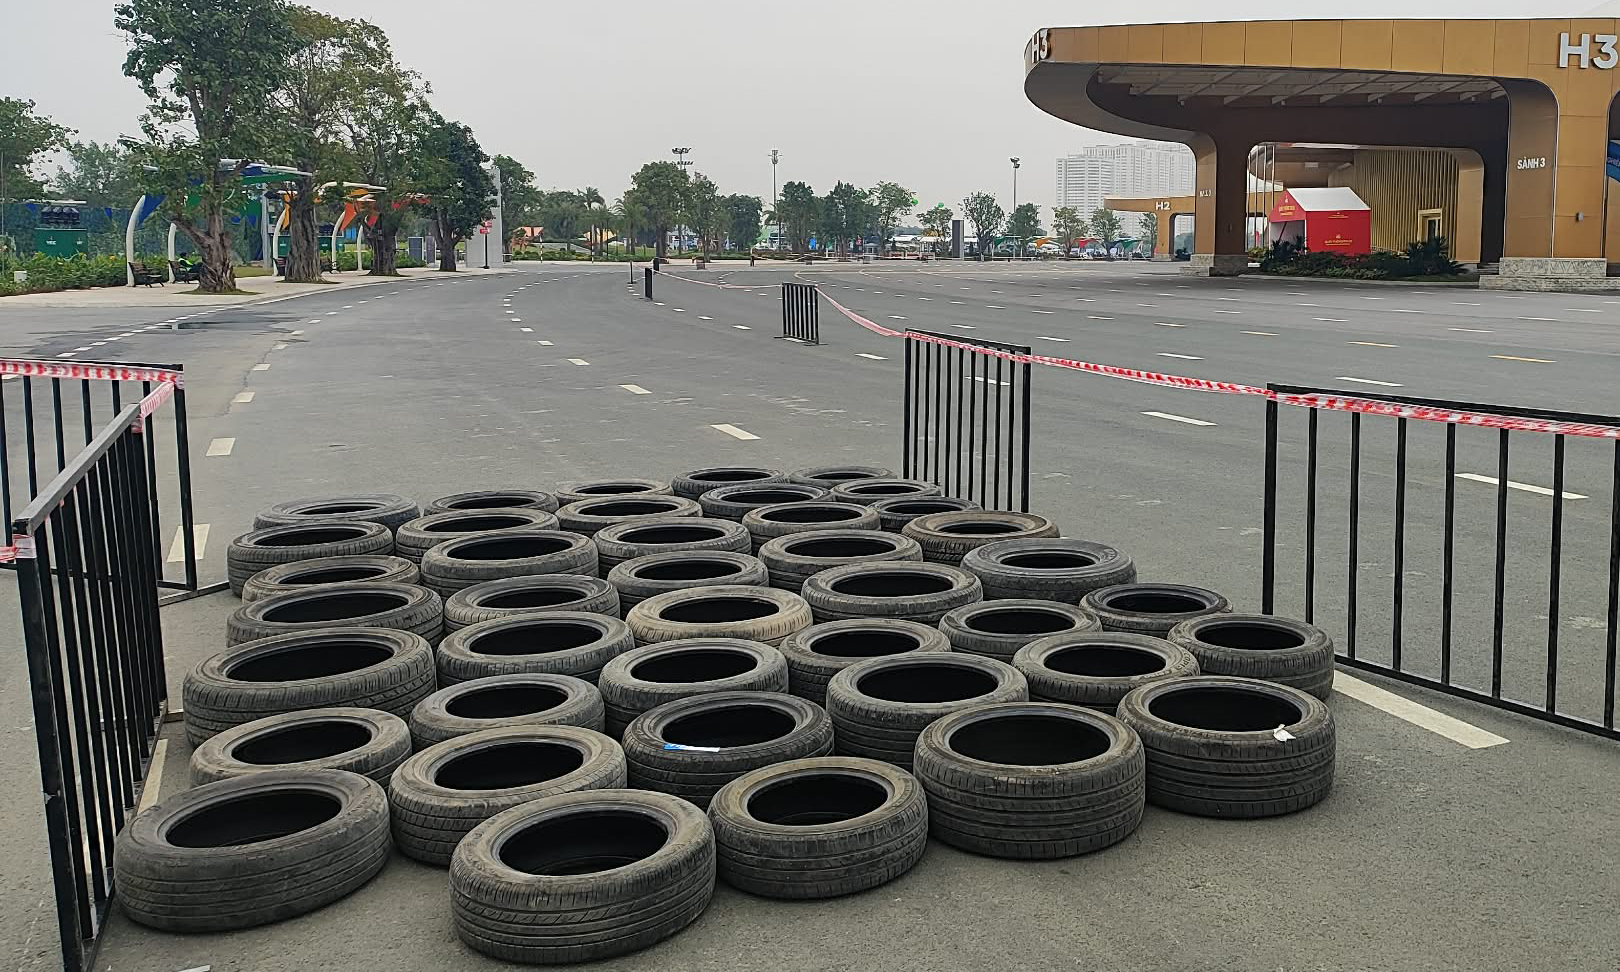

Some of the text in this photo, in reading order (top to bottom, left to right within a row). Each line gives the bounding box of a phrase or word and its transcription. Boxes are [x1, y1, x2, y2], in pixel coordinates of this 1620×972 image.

[1031, 29, 1049, 64] H3
[1559, 32, 1619, 69] H3
[1540, 157, 1546, 168] 3
[1155, 201, 1171, 211] H2
